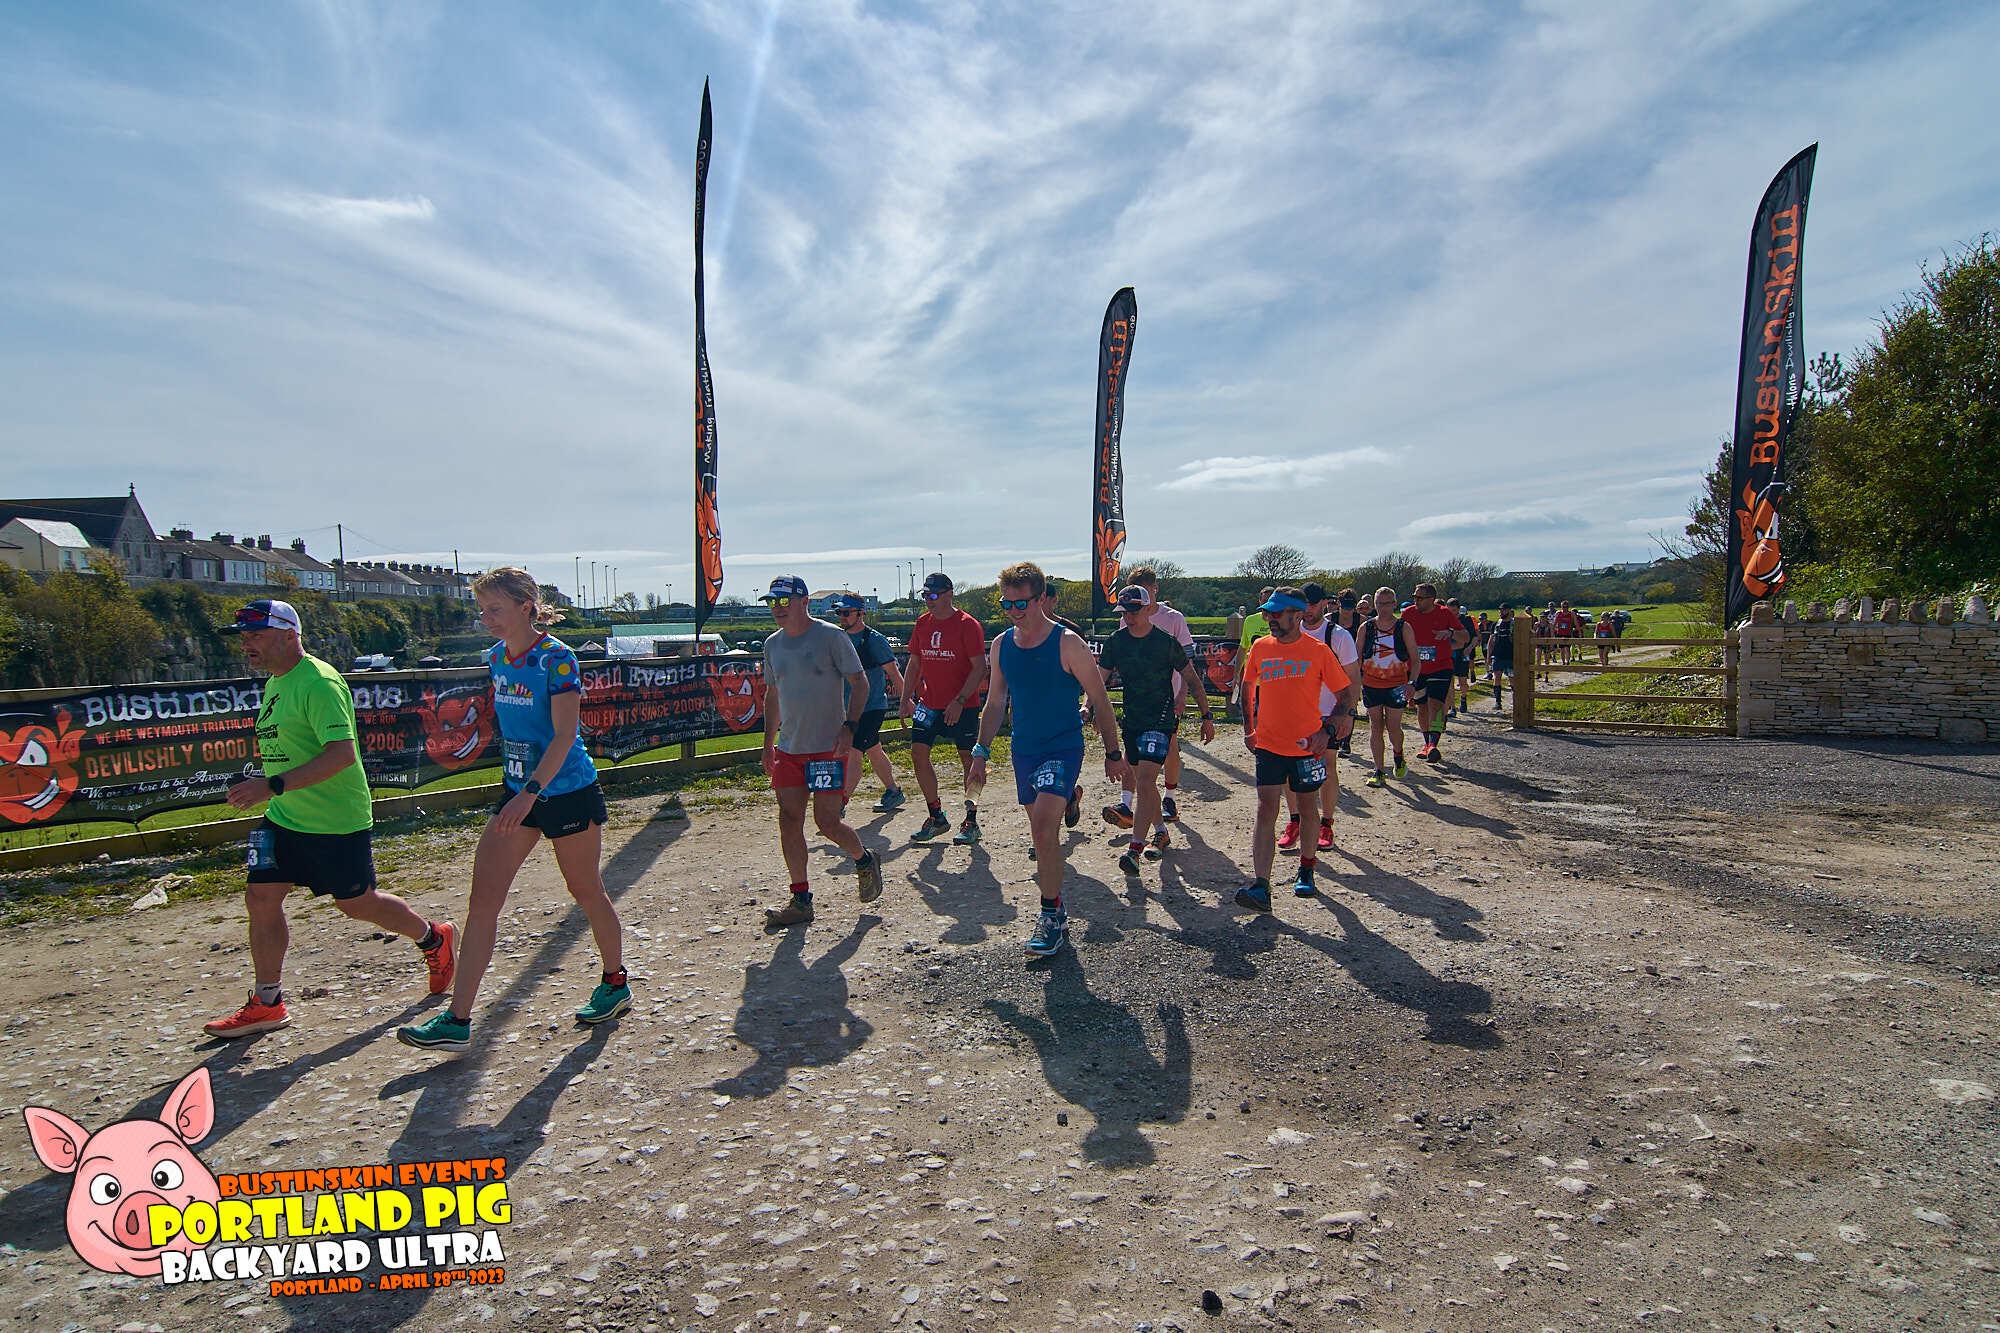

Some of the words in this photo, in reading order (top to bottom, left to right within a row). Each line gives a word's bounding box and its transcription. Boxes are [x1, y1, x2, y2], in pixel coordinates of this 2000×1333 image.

[1749, 203, 1798, 468] Bustinskin
[704, 417, 715, 463] Making
[627, 663, 697, 688] Events
[80, 684, 262, 728] Bustinski
[912, 709, 927, 722] 39
[96, 730, 112, 745] WE
[136, 722, 200, 741] WEYMOUTH
[366, 731, 405, 751] 2006
[1147, 742, 1156, 753] 6
[84, 742, 195, 780] DEVILISHLY
[202, 738, 248, 763] GOOD
[508, 759, 524, 778] 44
[814, 774, 832, 789] 42
[1037, 772, 1055, 787] 53
[1311, 767, 1327, 783] 32
